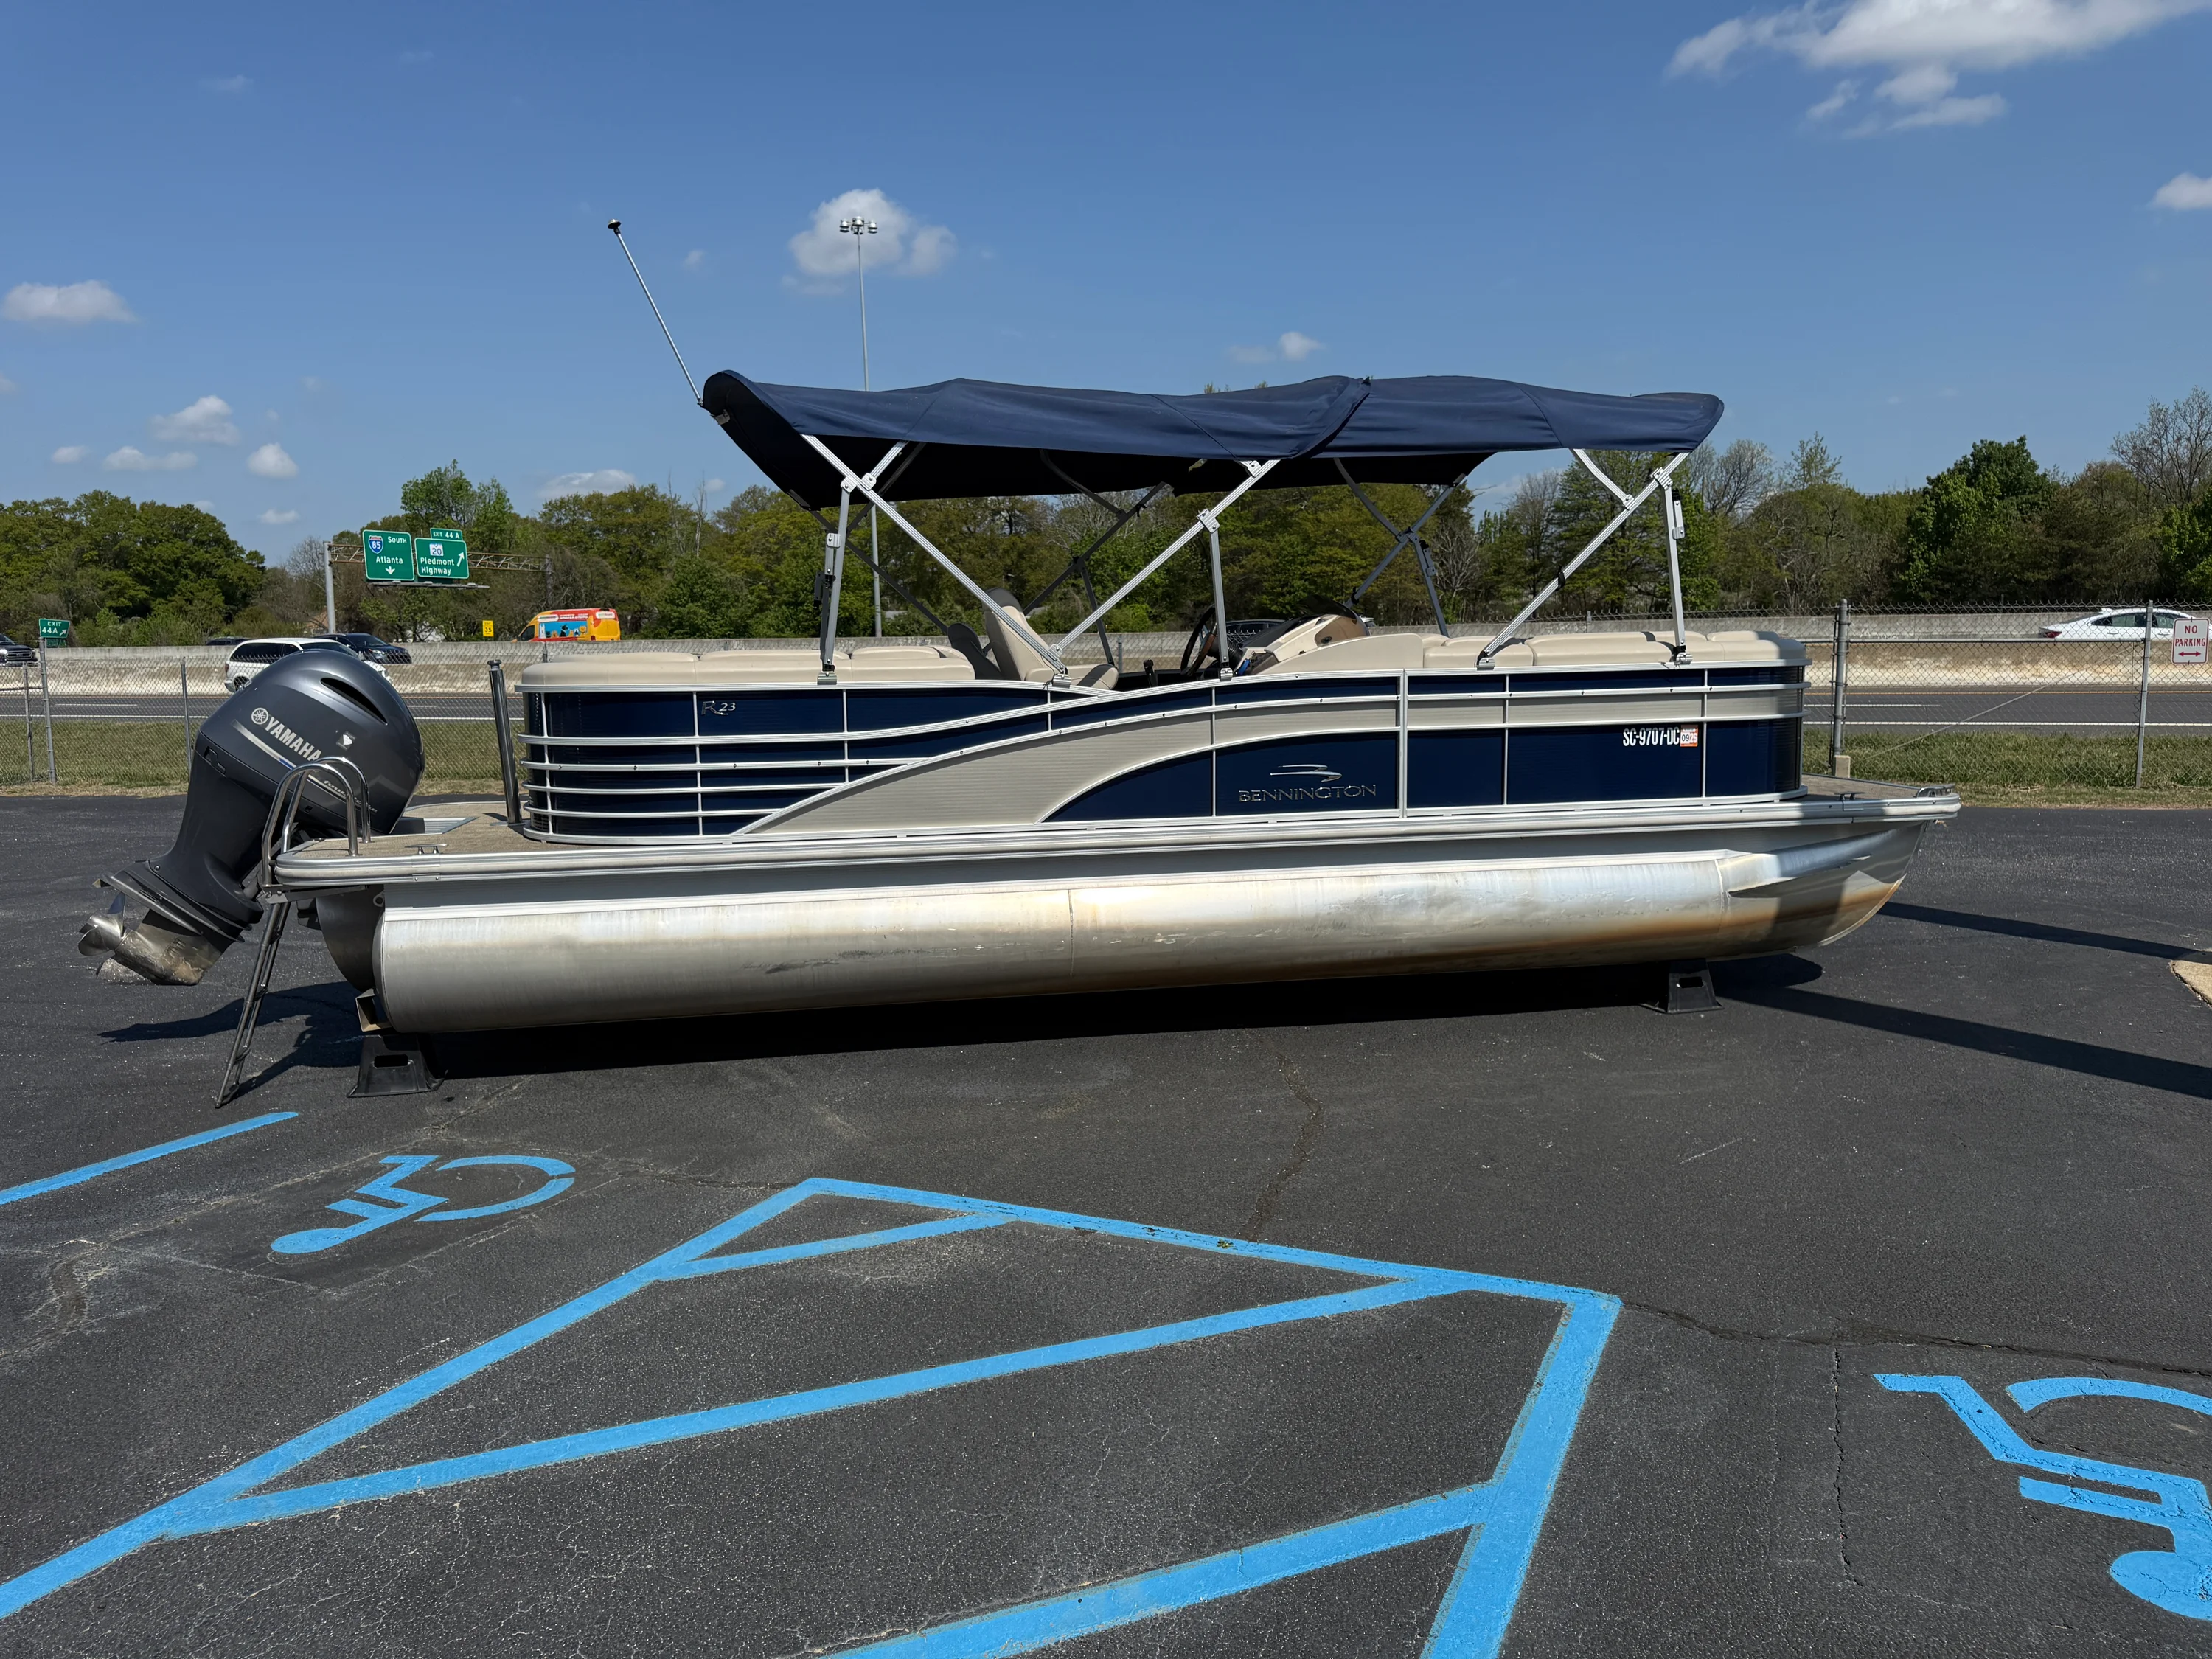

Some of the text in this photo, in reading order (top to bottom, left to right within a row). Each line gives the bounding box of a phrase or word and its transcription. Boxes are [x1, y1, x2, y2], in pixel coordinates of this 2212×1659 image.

[372, 541, 381, 549] 85
[376, 556, 403, 564] Atlanta
[420, 557, 455, 566] Piedmont
[421, 566, 451, 576] Highway
[2185, 625, 2198, 633] NO
[2174, 639, 2206, 647] PARKING
[264, 716, 322, 762] YAMAHA
[1238, 784, 1377, 802] BENNINGTON
